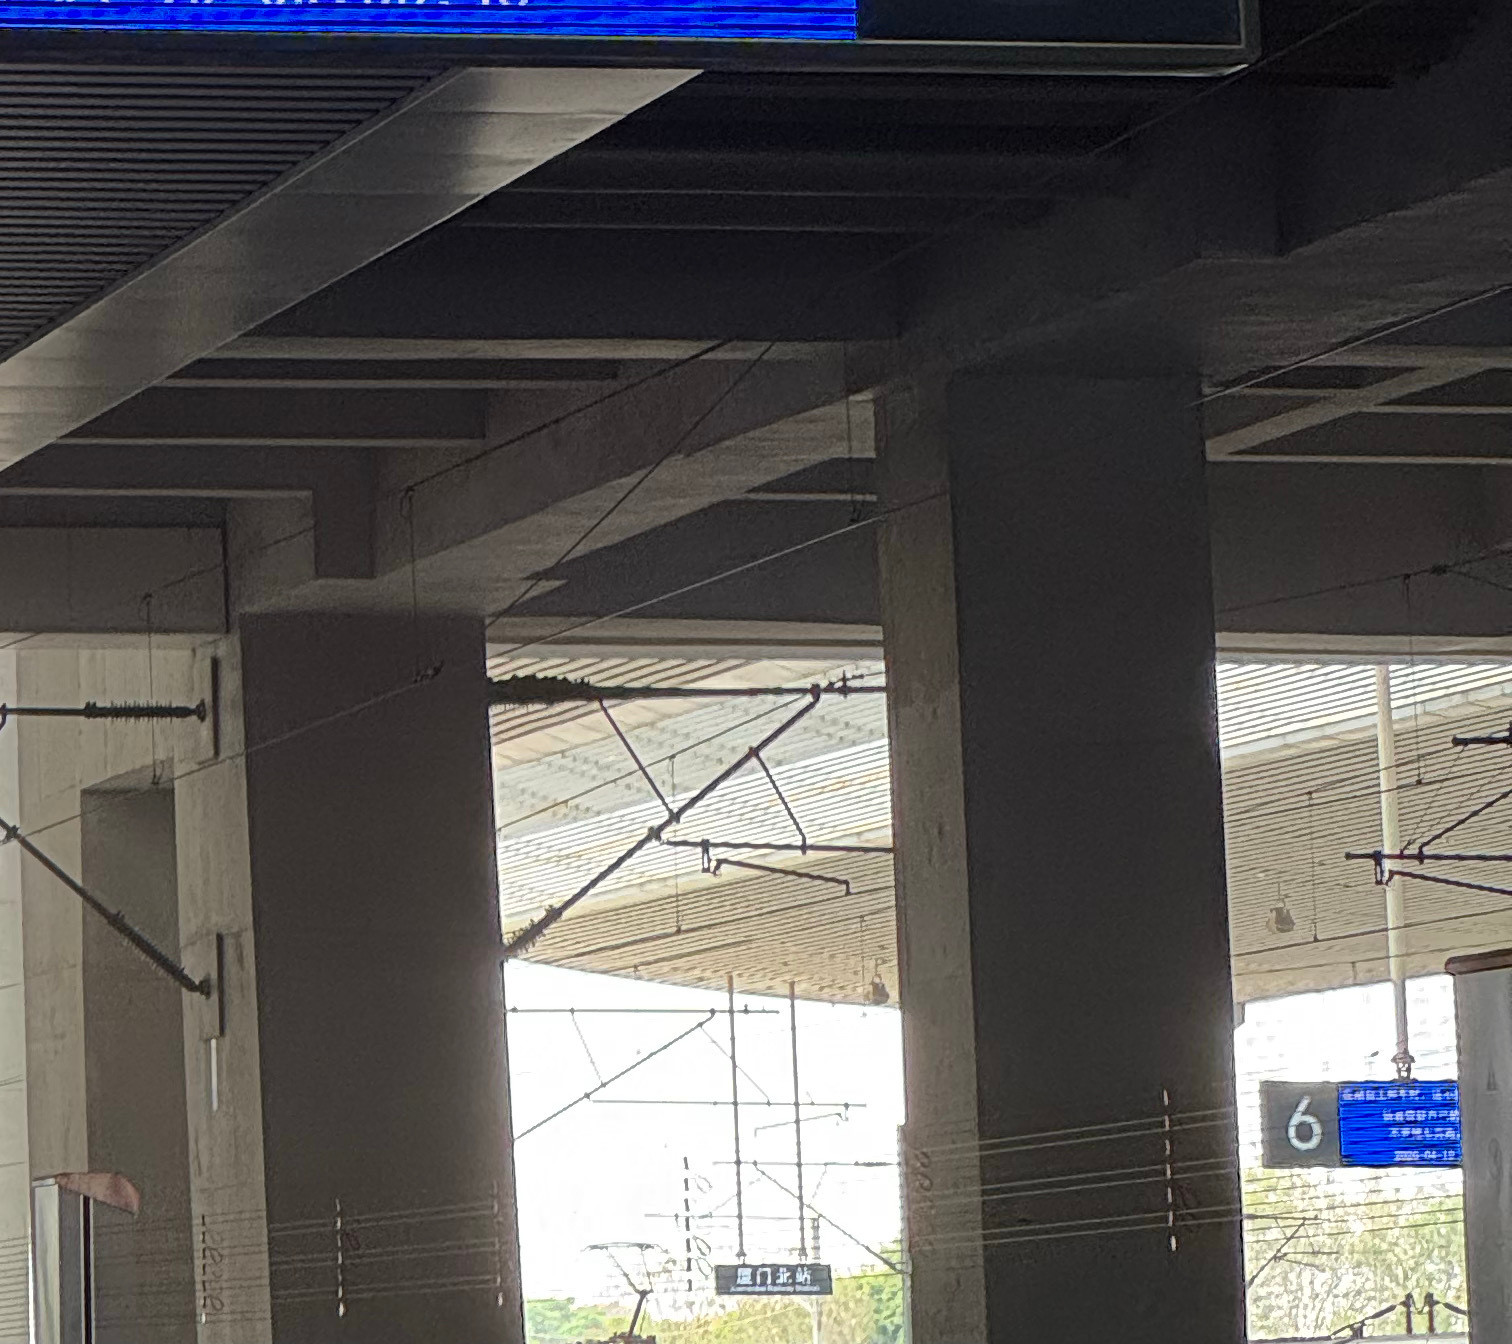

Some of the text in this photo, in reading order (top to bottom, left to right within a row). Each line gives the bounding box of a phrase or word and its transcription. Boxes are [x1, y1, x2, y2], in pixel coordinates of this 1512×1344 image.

[1286, 1095, 1323, 1152] 6
[736, 1266, 812, 1286] 厦门北站
